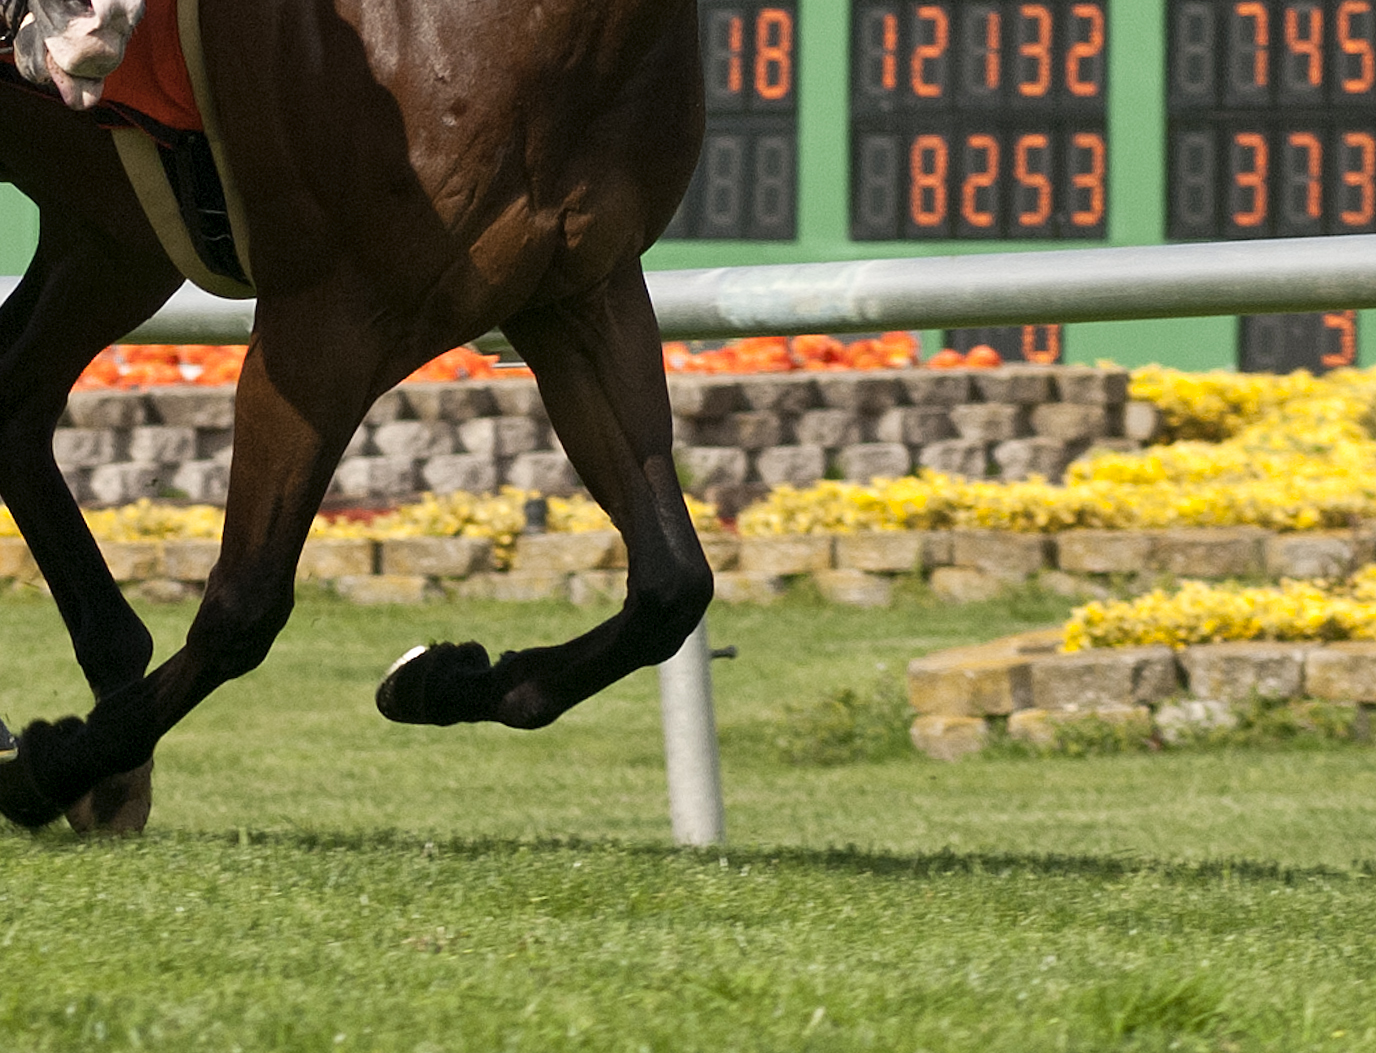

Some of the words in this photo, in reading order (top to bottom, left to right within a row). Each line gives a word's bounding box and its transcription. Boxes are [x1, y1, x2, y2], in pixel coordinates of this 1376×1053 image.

[727, 7, 793, 100] 18
[881, 3, 1105, 97] 12132
[1234, 0, 1376, 93] 745
[910, 133, 1106, 227] 8253
[1232, 132, 1376, 227] 373
